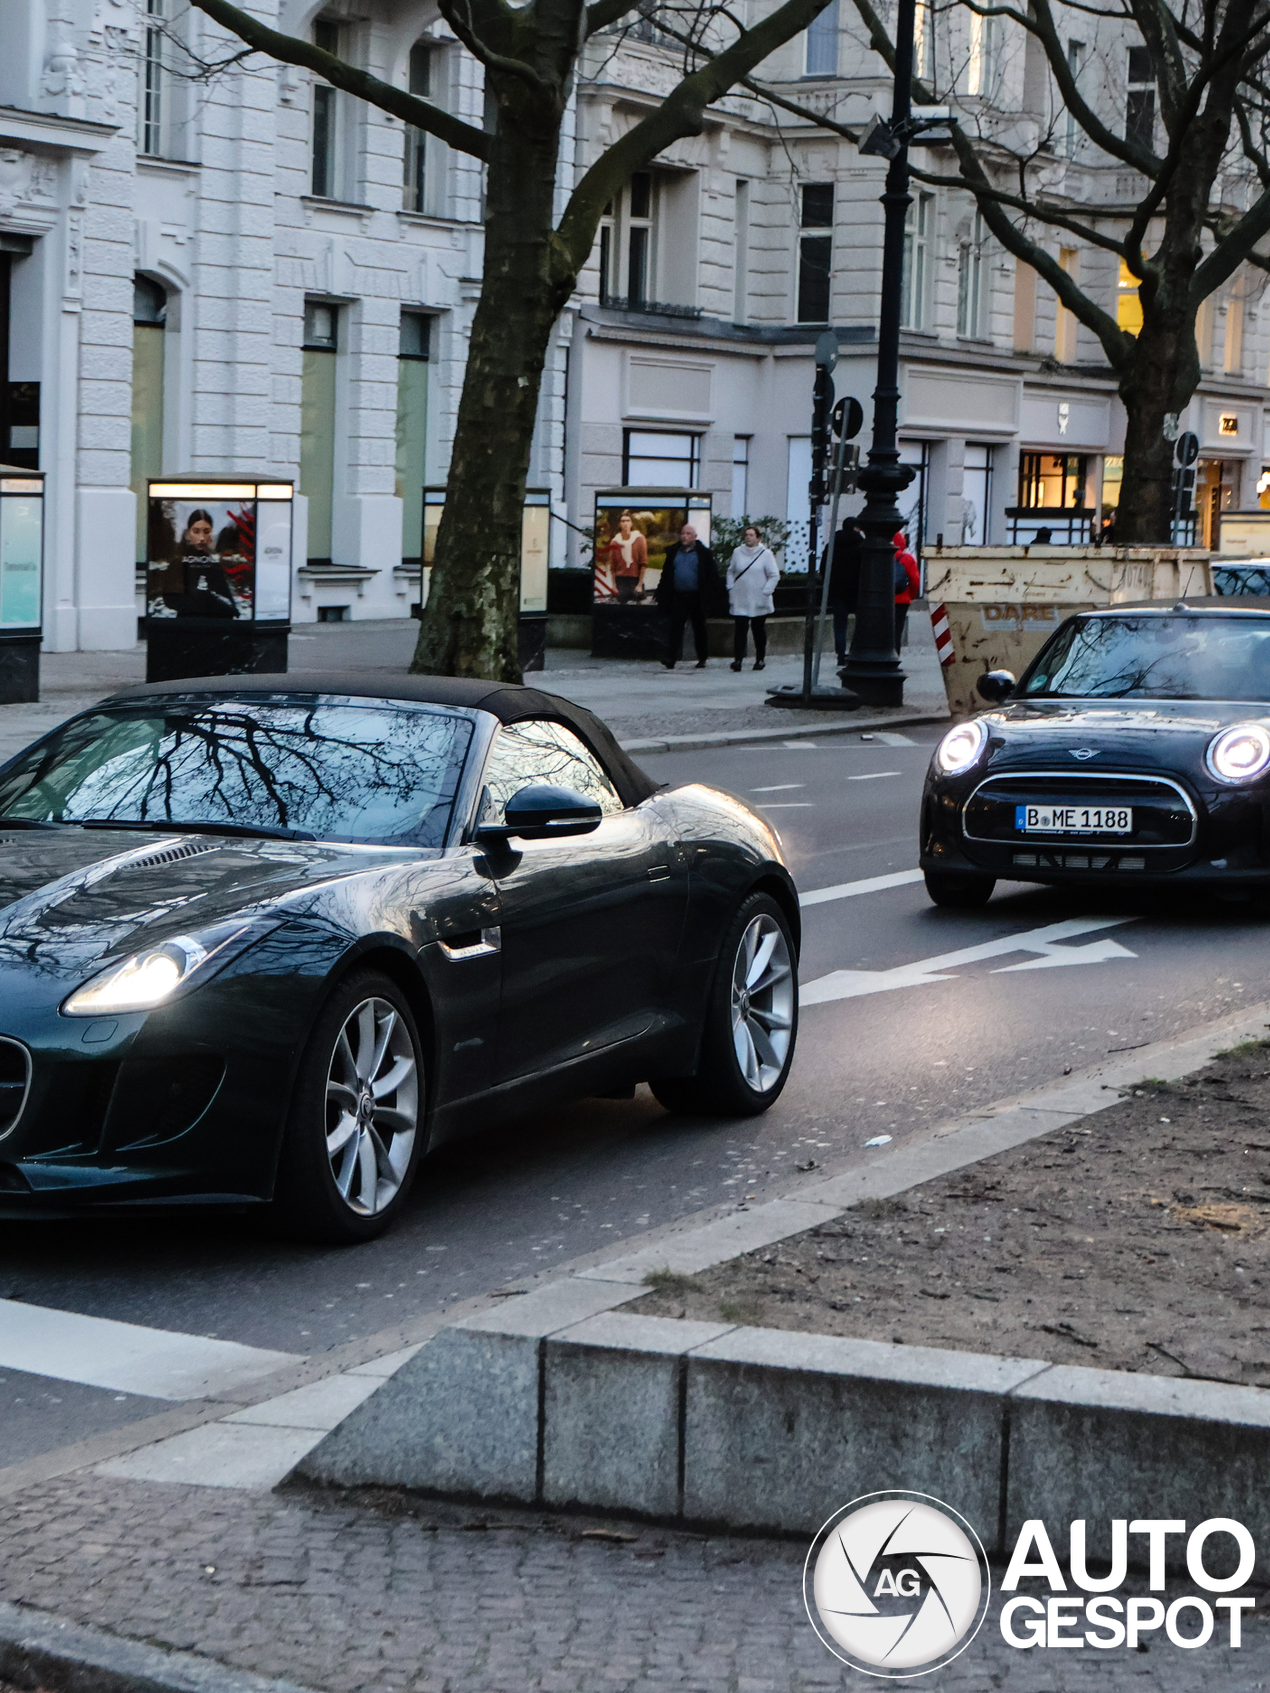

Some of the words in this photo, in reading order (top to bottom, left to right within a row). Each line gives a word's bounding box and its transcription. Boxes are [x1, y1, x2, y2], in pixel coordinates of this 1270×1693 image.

[984, 605, 1056, 620] DARE
[1027, 809, 1039, 826] B
[1052, 809, 1076, 828] ME
[1080, 810, 1129, 829] 1188
